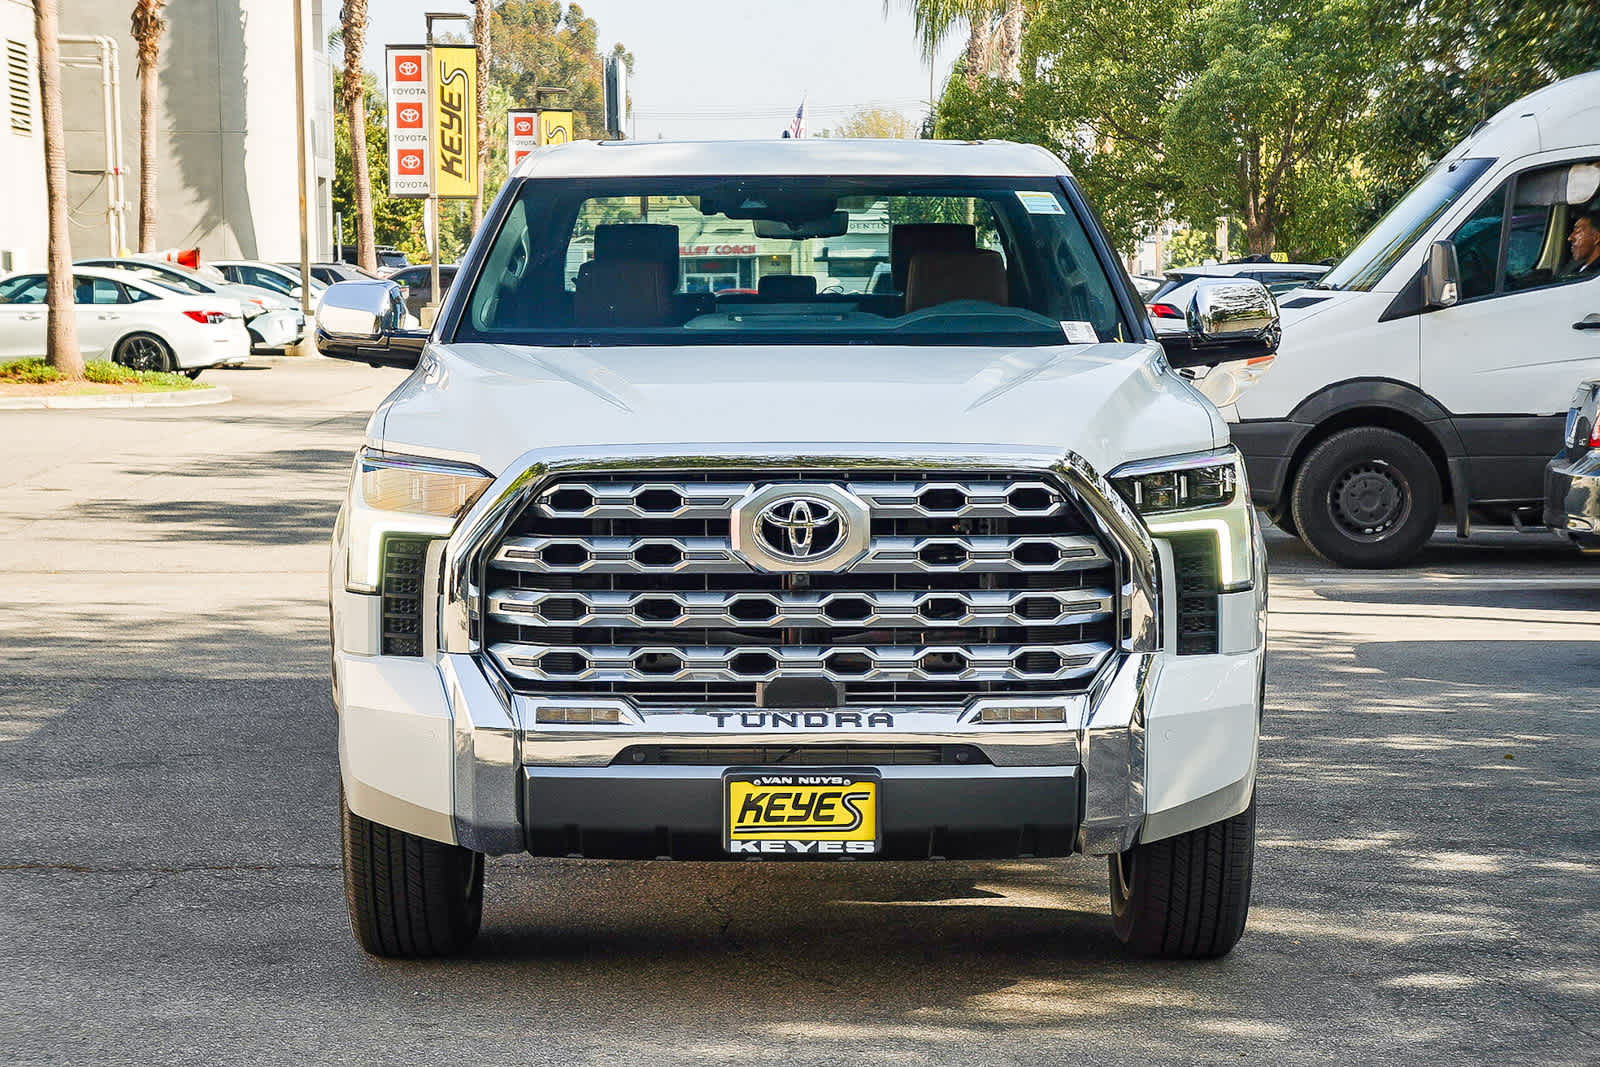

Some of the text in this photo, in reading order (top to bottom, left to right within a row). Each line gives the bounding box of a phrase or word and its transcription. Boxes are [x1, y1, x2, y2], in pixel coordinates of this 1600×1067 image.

[439, 60, 470, 183] KEYES
[393, 134, 428, 142] TOYOTA
[394, 181, 429, 189] TOYOTA
[715, 245, 756, 255] COACH
[707, 712, 894, 728] TUNDRA
[761, 776, 844, 785] VAN NUYS
[733, 792, 871, 832] KEYES
[730, 840, 875, 853] KEYES
